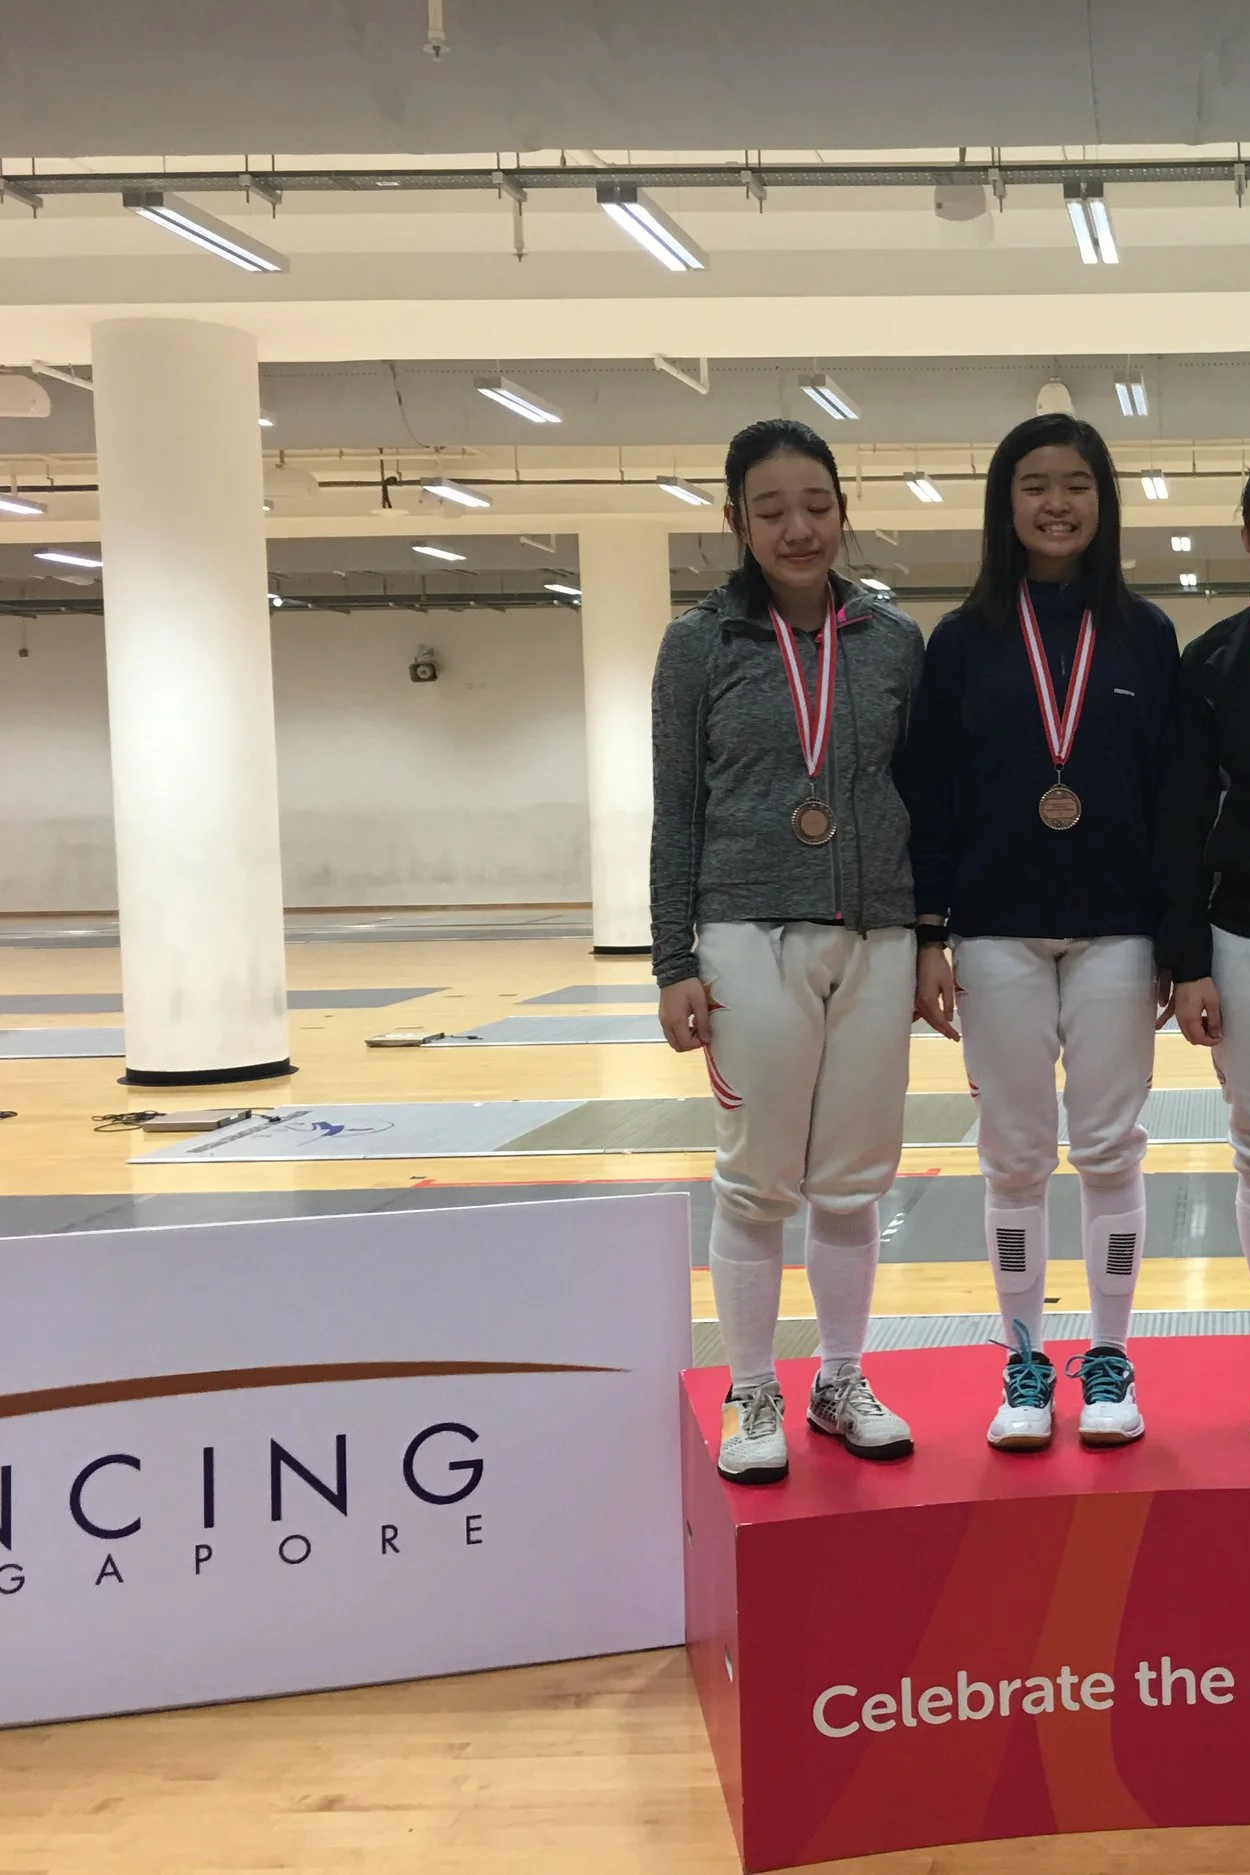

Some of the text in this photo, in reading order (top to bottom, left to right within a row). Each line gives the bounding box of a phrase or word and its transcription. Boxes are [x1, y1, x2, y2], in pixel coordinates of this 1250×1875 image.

[0, 1422, 484, 1552] CING
[812, 1665, 1115, 1738] Celebrate
[1134, 1656, 1235, 1707] the
